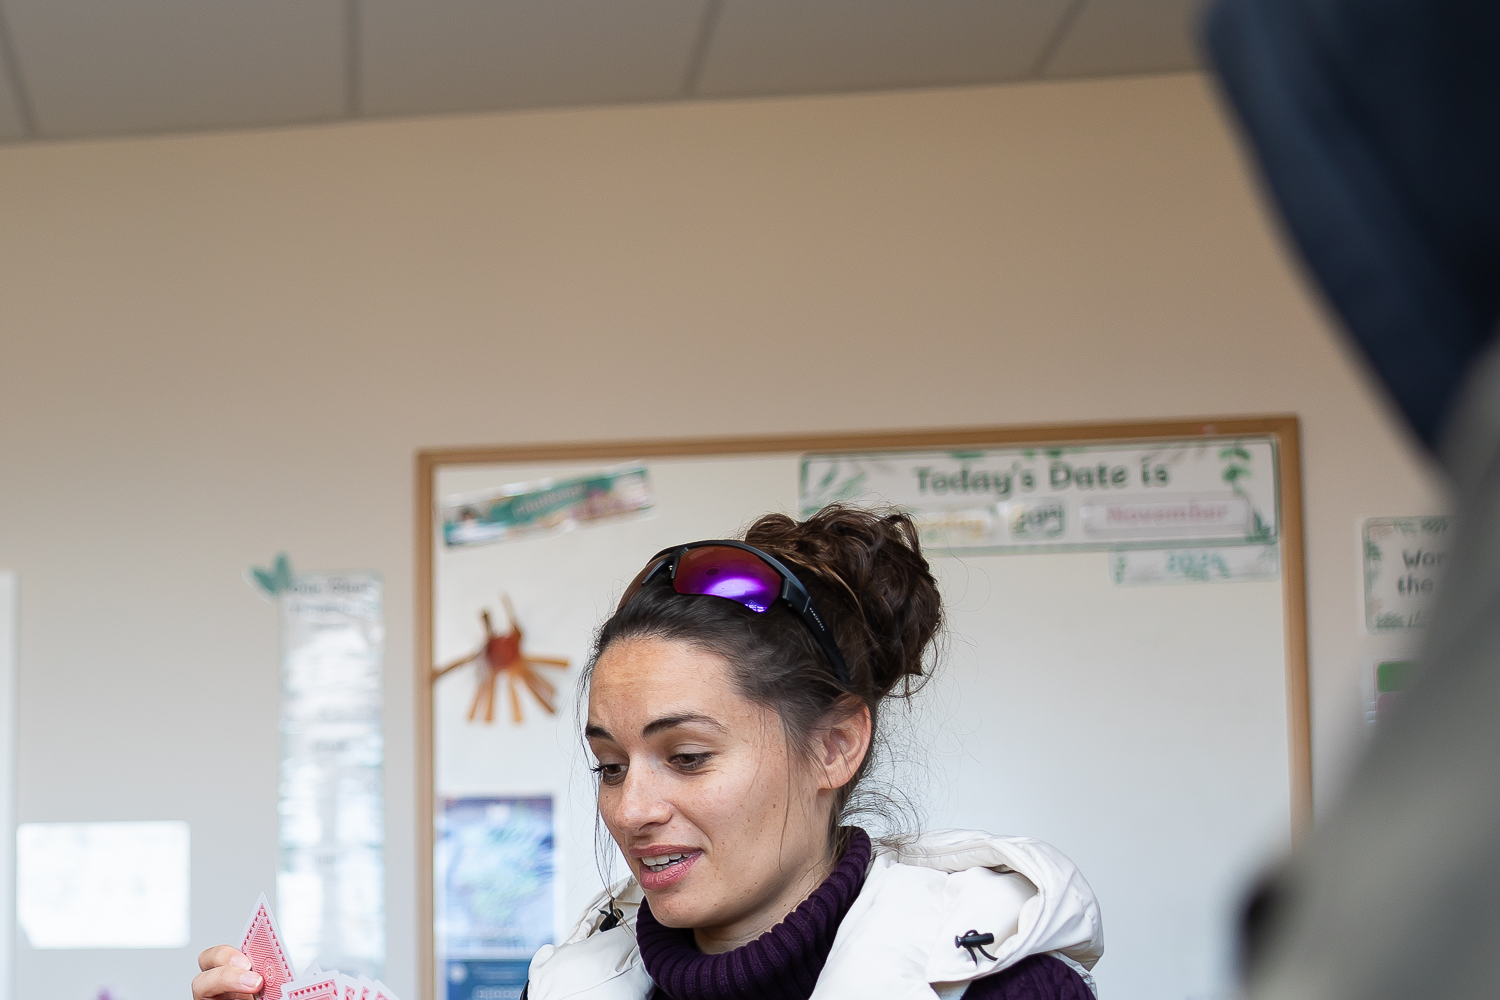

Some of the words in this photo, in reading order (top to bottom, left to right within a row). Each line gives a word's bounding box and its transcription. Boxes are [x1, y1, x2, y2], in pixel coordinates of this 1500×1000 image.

[915, 462, 1035, 497] Today's
[1049, 460, 1128, 491] Date
[1140, 456, 1172, 487] is
[1107, 501, 1228, 523] November
[1401, 548, 1446, 569] Wor
[1397, 574, 1434, 597] the
